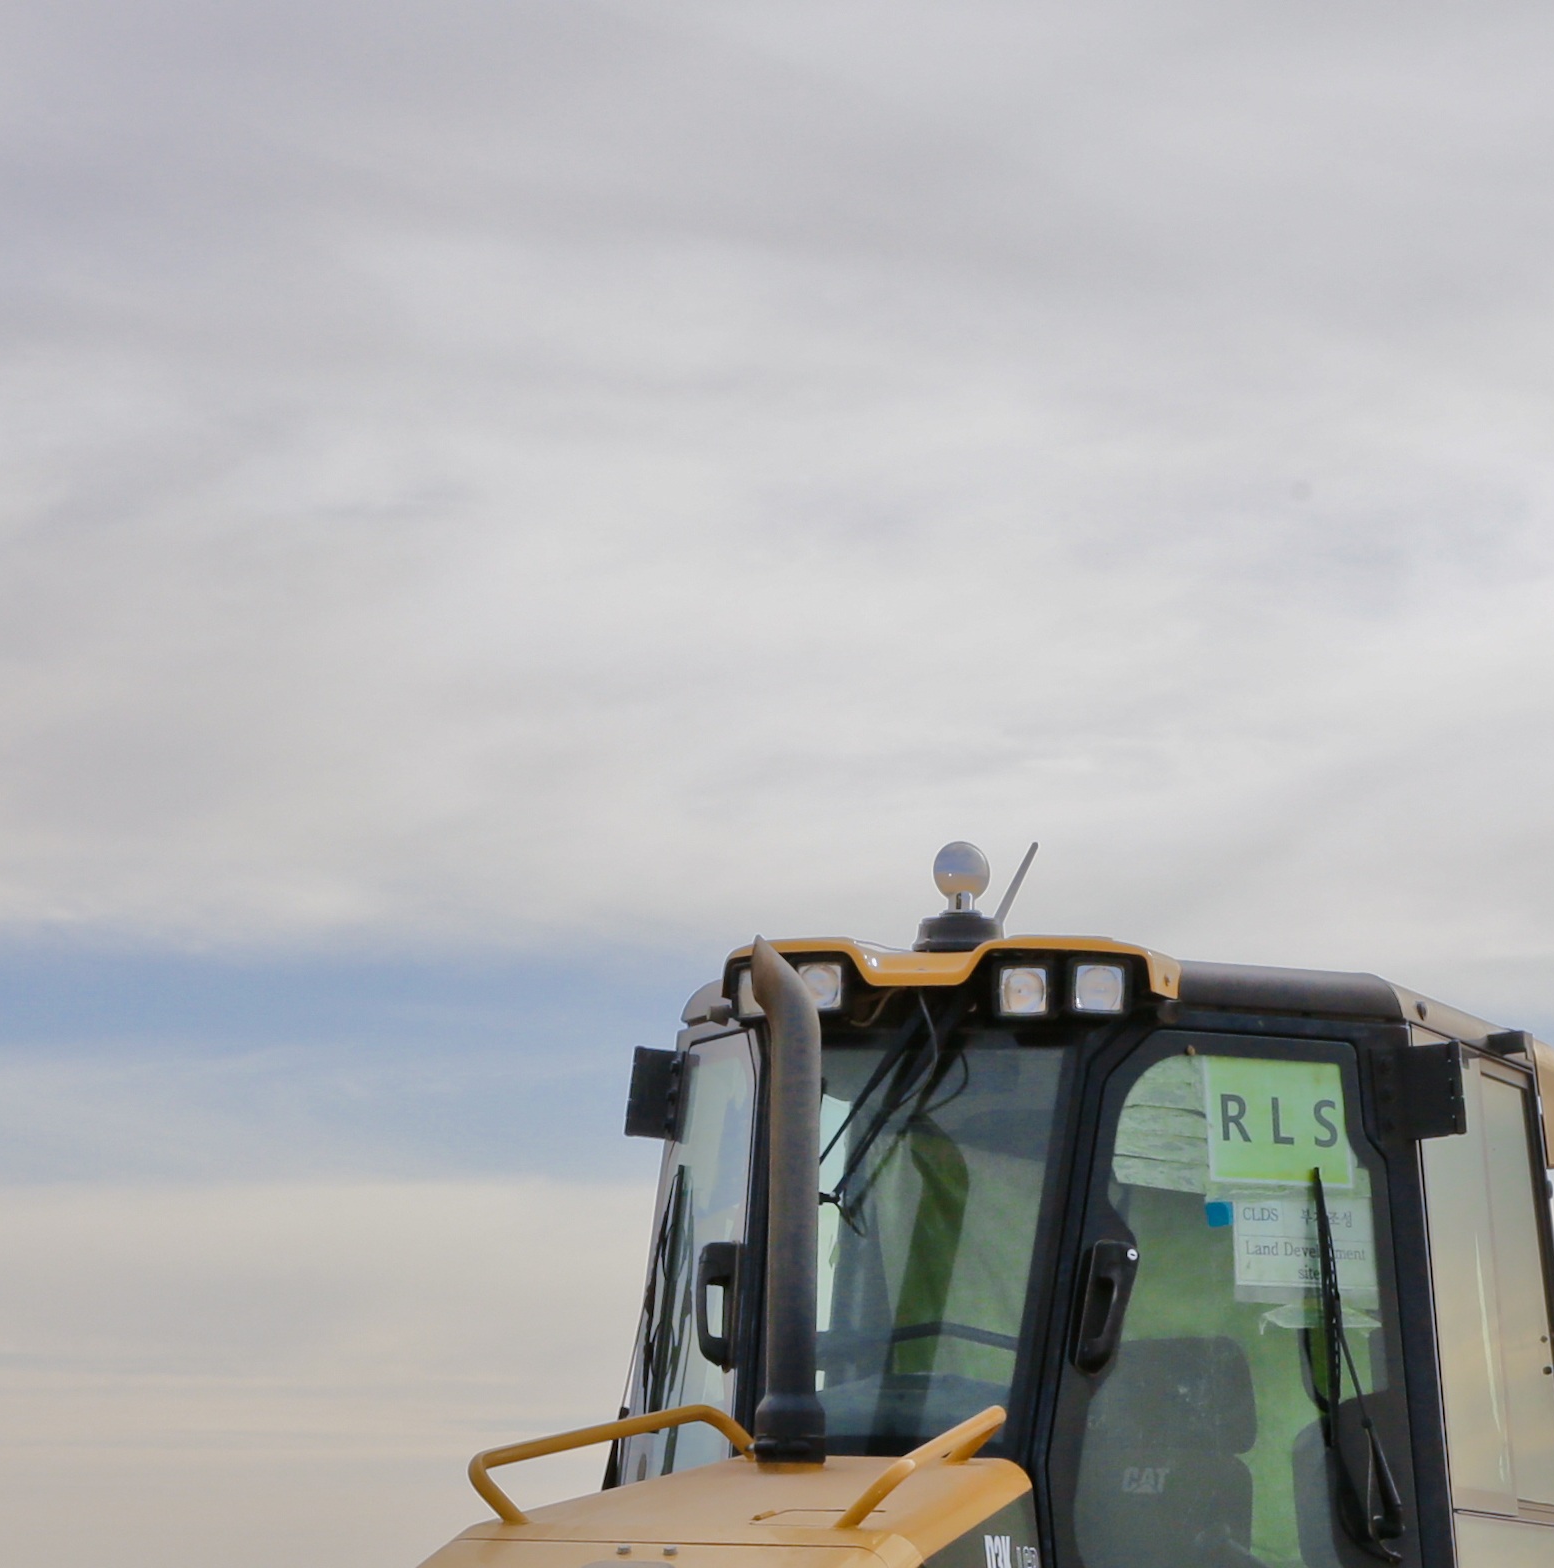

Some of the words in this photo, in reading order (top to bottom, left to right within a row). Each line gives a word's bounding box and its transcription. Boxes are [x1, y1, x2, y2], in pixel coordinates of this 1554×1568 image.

[1243, 1207, 1279, 1221] CLDS
[1246, 1240, 1279, 1256] Land
[1284, 1242, 1366, 1260] Develment
[1298, 1264, 1320, 1280] site
[1122, 1467, 1170, 1494] CAT
